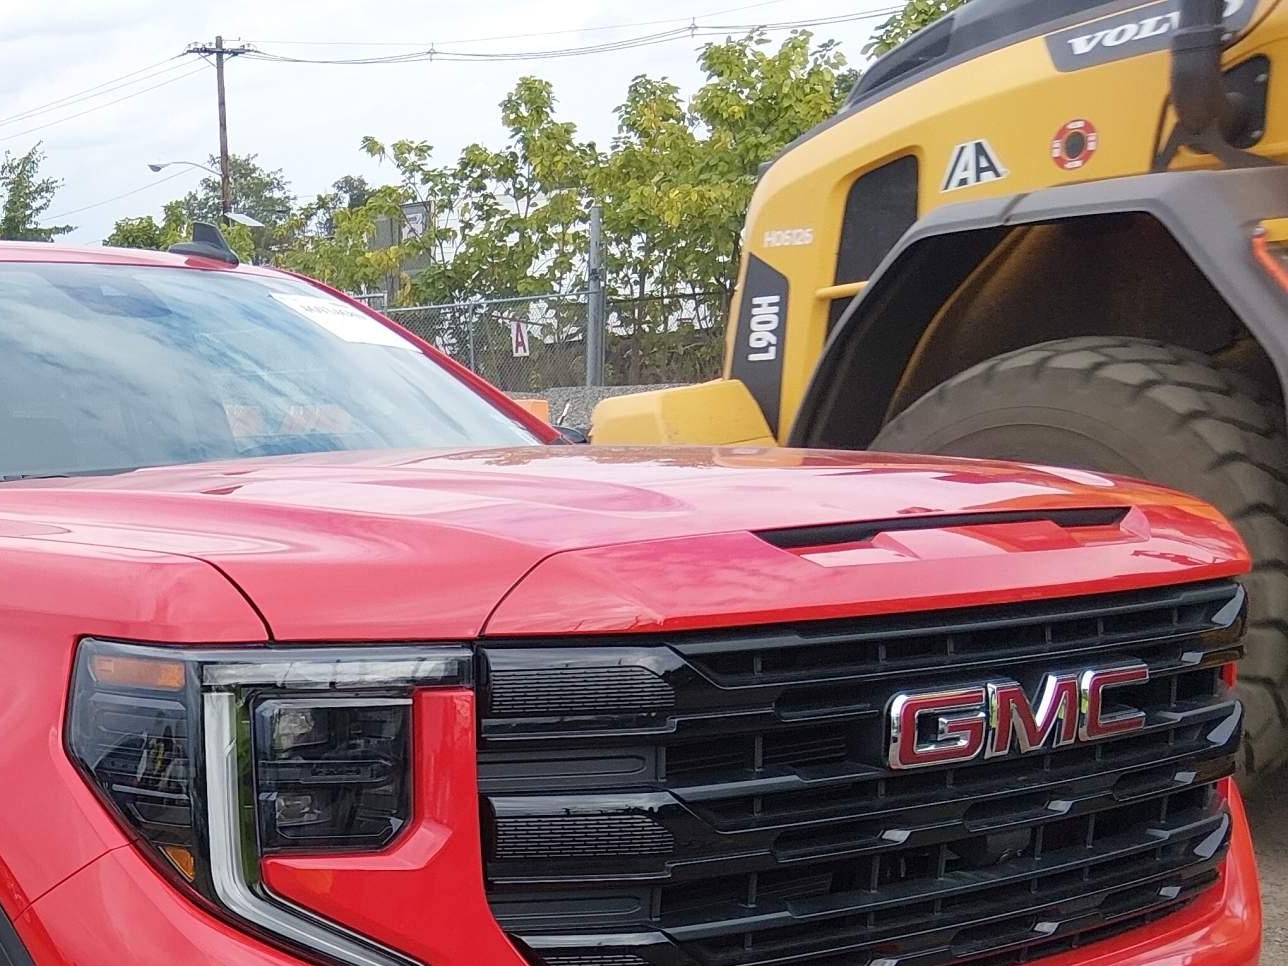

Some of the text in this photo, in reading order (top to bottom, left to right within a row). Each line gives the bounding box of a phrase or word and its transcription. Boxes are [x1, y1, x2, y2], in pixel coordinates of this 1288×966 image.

[515, 321, 527, 354] A
[747, 295, 781, 361] L90H
[888, 663, 1150, 770] GMC
